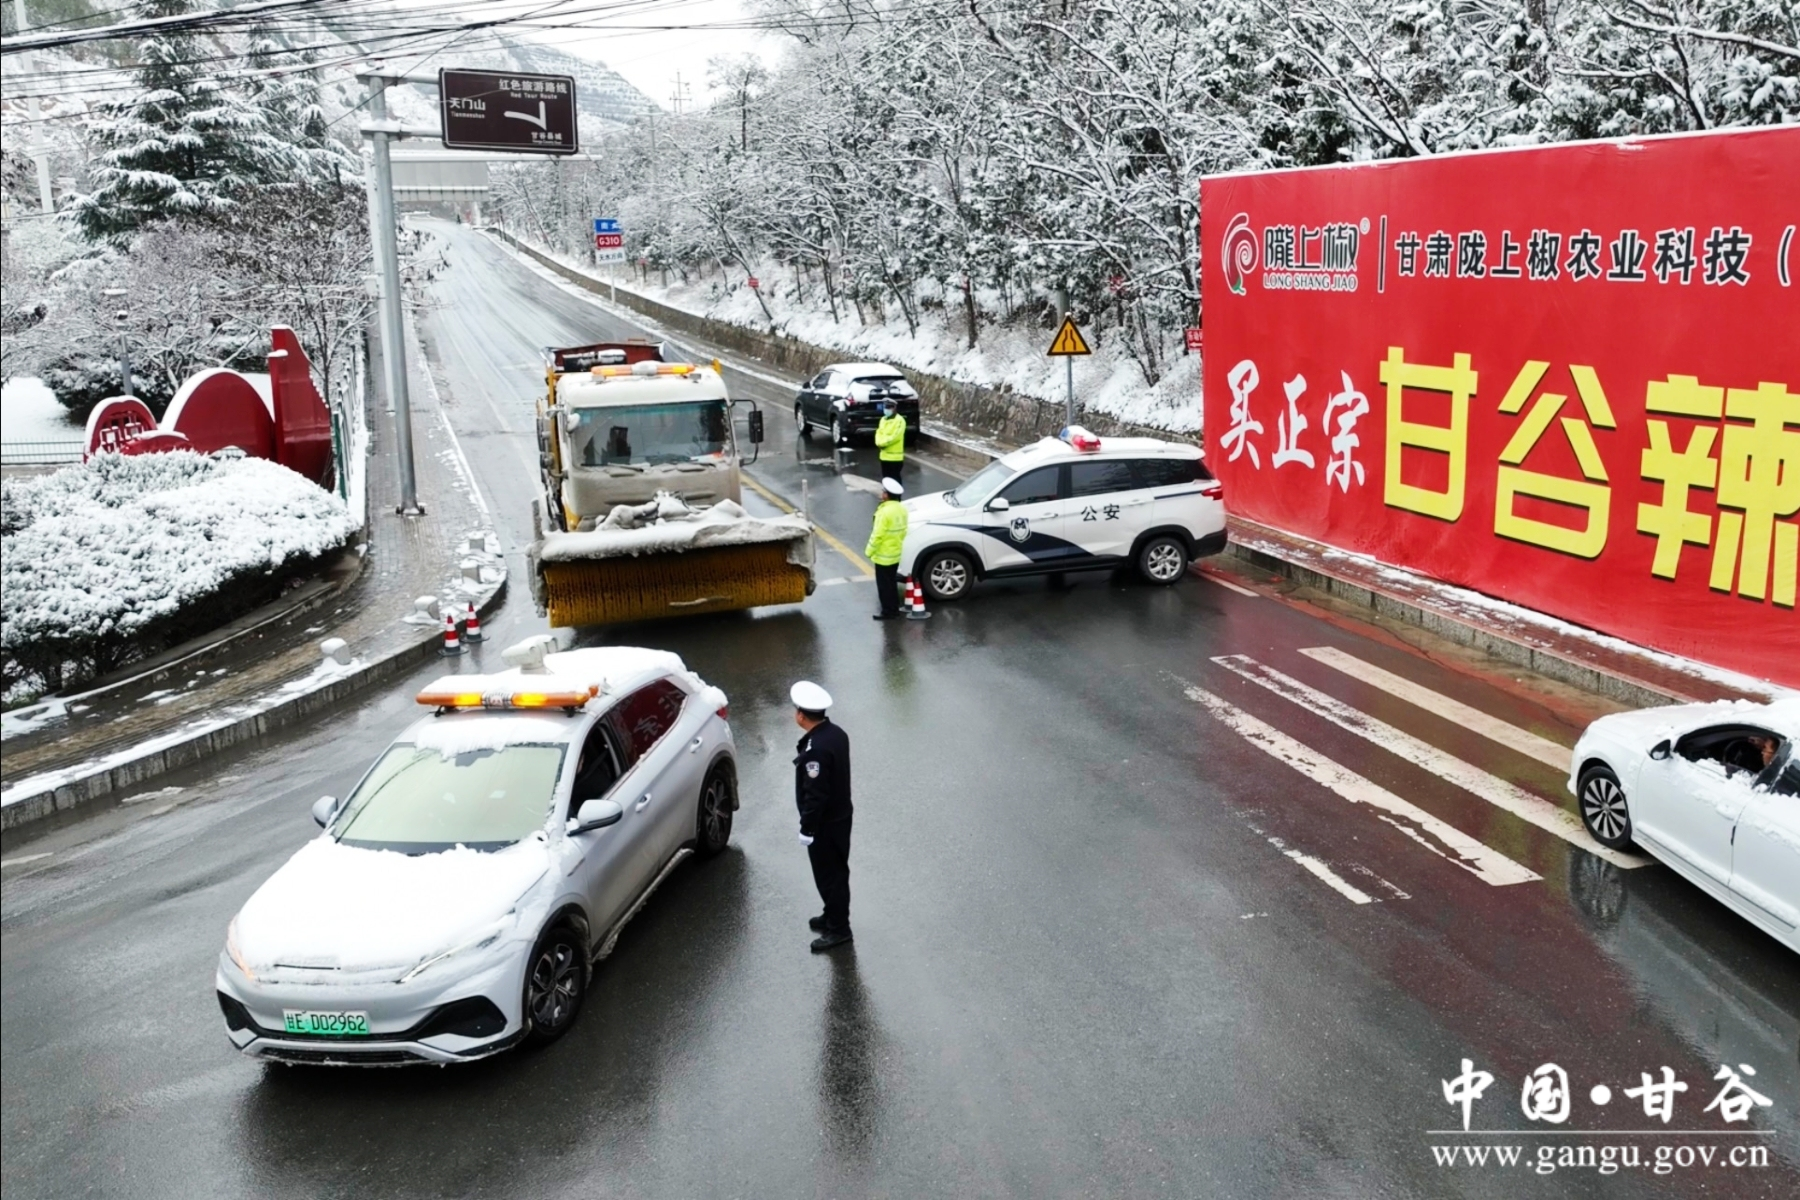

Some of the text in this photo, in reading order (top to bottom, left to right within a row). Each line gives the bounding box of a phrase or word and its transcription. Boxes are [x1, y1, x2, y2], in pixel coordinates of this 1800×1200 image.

[499, 79, 567, 94] 红色旅游路线
[449, 97, 486, 111] 天门山
[599, 236, 620, 246] G310
[1264, 273, 1358, 291] LONG SHANG JIAO
[1081, 503, 1120, 522] 公安
